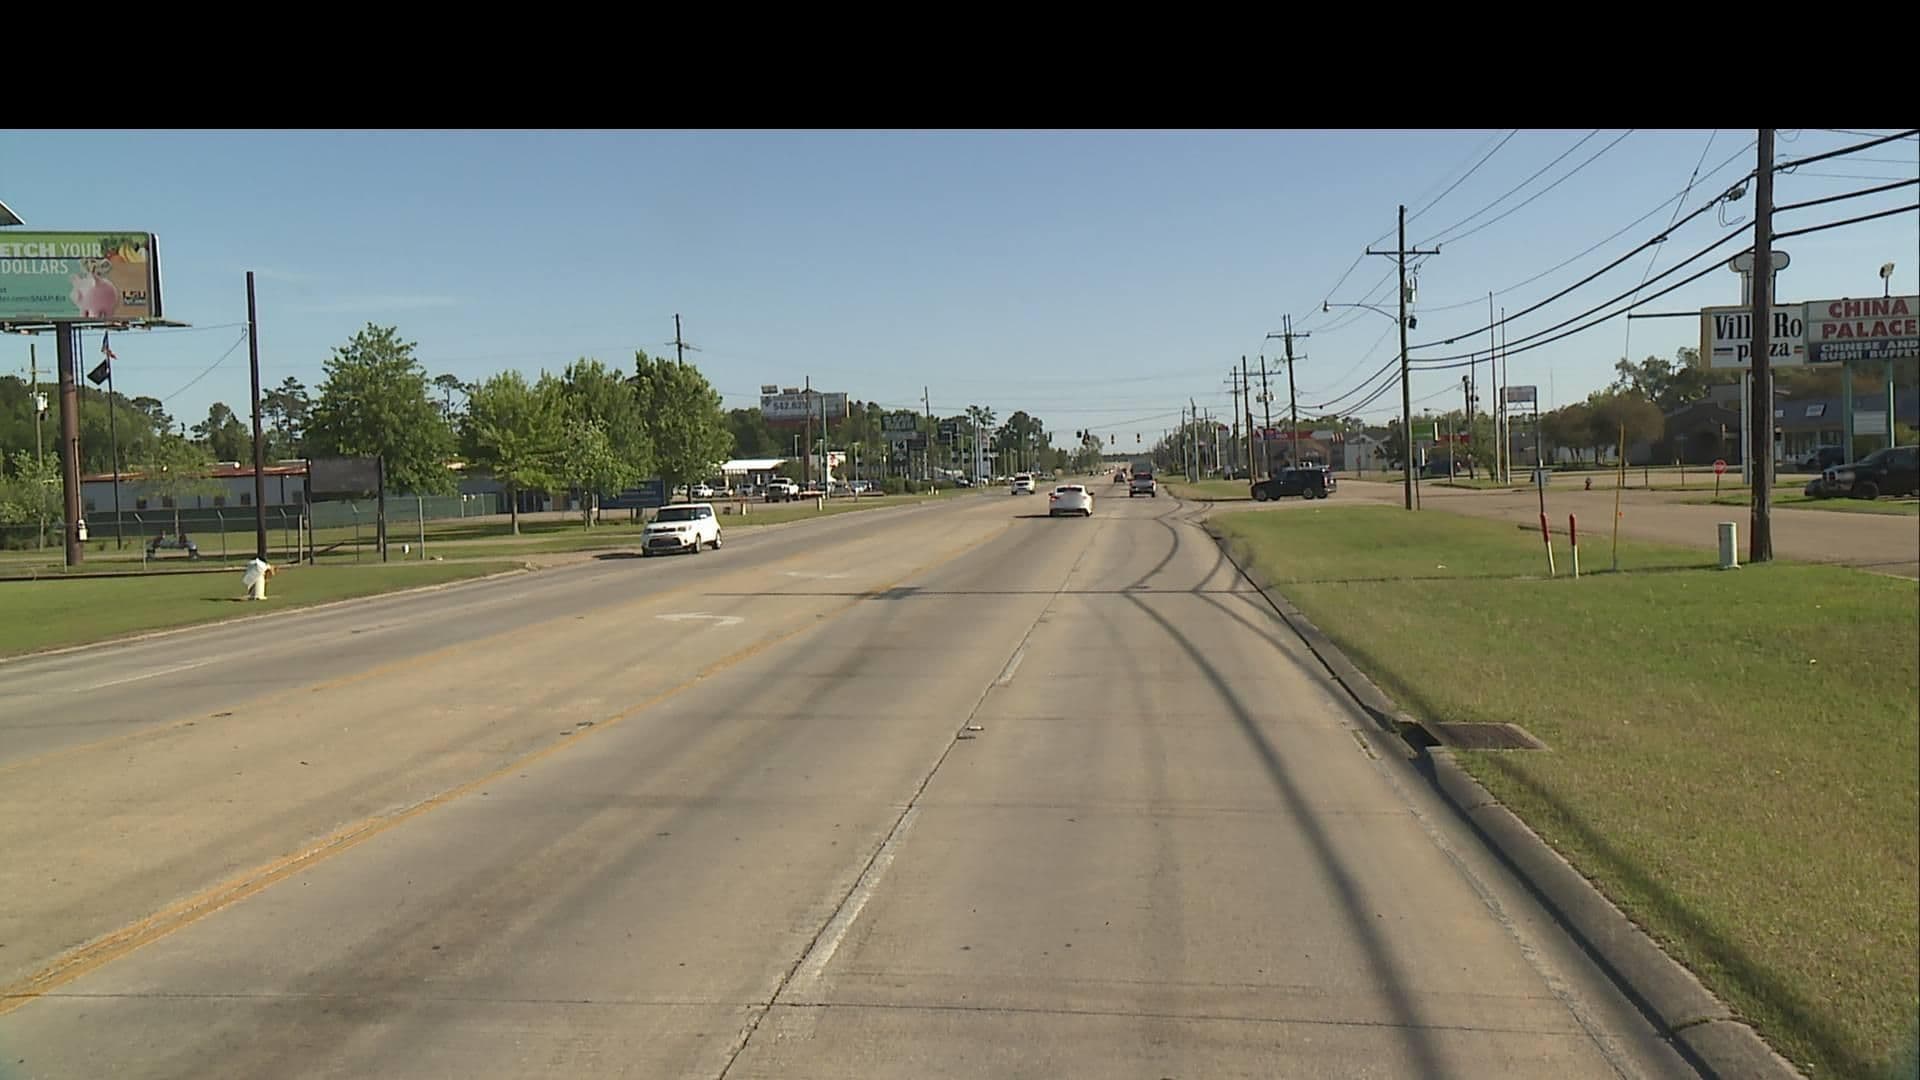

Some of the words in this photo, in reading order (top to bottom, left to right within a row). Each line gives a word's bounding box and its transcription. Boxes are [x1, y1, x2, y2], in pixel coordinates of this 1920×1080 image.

[60, 243, 104, 257] YOUR
[1, 259, 69, 274] DOLLARS
[1828, 299, 1909, 318] CHINA
[1714, 314, 1752, 340] Vill
[1773, 312, 1803, 338] Ro
[1822, 320, 1918, 339] PALACE
[1736, 341, 1791, 362] plza
[1821, 341, 1880, 352] CHINESE
[1887, 340, 1919, 349] AND
